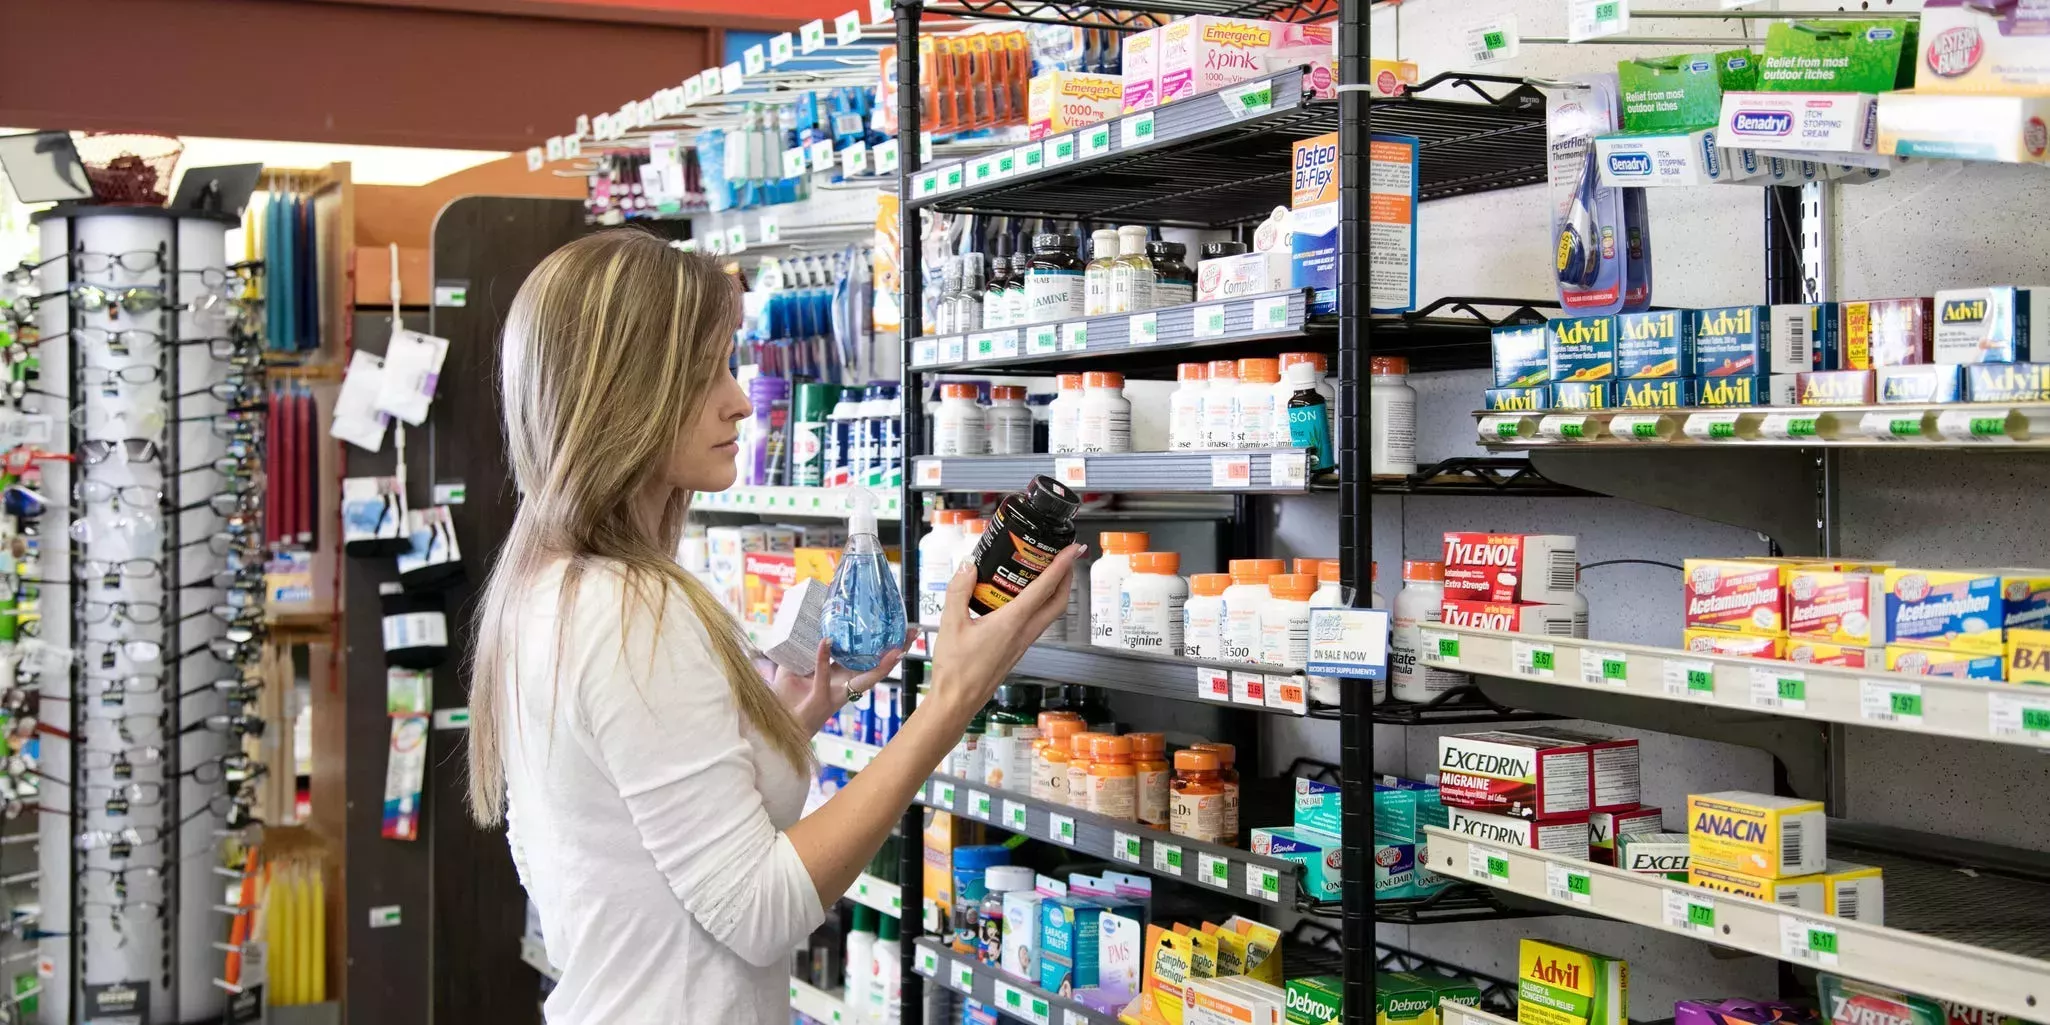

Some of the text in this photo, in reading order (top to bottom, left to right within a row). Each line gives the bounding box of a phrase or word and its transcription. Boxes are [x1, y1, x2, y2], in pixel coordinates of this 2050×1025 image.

[1596, 4, 1613, 18] 6.99
[1217, 50, 1259, 71] pink
[1766, 56, 1848, 69] Relief from most
[1763, 69, 1835, 81] outdoor itches
[1625, 89, 1685, 102] Relief from most
[1063, 104, 1105, 119] 1000 mg
[1627, 100, 1678, 113] outdoor itches
[1804, 110, 1823, 118] ITCH
[1737, 115, 1788, 132] Benadryl
[1803, 120, 1842, 128] STOPPING
[1802, 129, 1829, 137] CREAM
[1296, 144, 1336, 169] Osteo
[1552, 151, 1583, 161] Thermome
[1706, 135, 1718, 174] Benadryl
[1611, 156, 1649, 173] Benadryl
[1658, 159, 1686, 167] STOPPING
[1295, 168, 1333, 196] Bi-Flex
[1944, 301, 1985, 321] Advil
[1619, 312, 1675, 341] Advil
[1698, 308, 1753, 337] Advil
[1552, 317, 1609, 345] Advil
[1554, 383, 1603, 408] Advil
[1621, 381, 1679, 407] Advil
[1700, 377, 1752, 404] Advil
[1494, 388, 1537, 410] Advil
[1563, 424, 1580, 435] 5.77
[1636, 424, 1653, 436] 5.77
[1712, 423, 1730, 434] 5.77
[1791, 420, 1812, 433] 6.27
[1975, 420, 2000, 433] 6.27
[1022, 533, 1036, 545] 30
[1443, 536, 1517, 567] TYLENOL
[996, 565, 1029, 588] CEE
[1444, 580, 1490, 591] Extra Strength
[1689, 586, 1778, 616] Acetaminophen
[1792, 596, 1864, 622] Acetaminophen
[1896, 594, 1990, 623] Acetaminophen
[1442, 604, 1513, 632] TYLENOL
[1124, 635, 1163, 649] Arginine
[1315, 627, 1346, 641] BEST
[1314, 649, 1367, 661] ON SALE NOW
[1535, 652, 1551, 666] 5.67
[2013, 647, 2050, 673] BA
[1336, 666, 1377, 676] SUPPLEMENTS
[1603, 661, 1621, 675] 11.97
[1688, 673, 1706, 685] 4.49
[1285, 688, 1301, 701] 19.77
[1777, 680, 1796, 695] 3.17
[1892, 695, 1914, 711] 7.97
[1442, 746, 1530, 779] EXCEDRIN
[1050, 777, 1061, 788] C
[1441, 772, 1490, 790] MIGRAINE
[1178, 804, 1191, 816] D3
[1453, 814, 1525, 846] EXCEDRIN
[1694, 812, 1768, 844] ANACIN
[1263, 876, 1276, 889] 4.72
[1326, 881, 1342, 891] ON
[1375, 872, 1414, 889] ONE DAILY
[1568, 874, 1584, 890] 6.27
[1692, 905, 1711, 918] 7.77
[1046, 936, 1068, 951] TABLETS
[1813, 932, 1834, 948] 6.17
[1108, 944, 1130, 963] PMS
[1156, 949, 1189, 970] Campho-
[1530, 954, 1580, 990] Advil
[1521, 981, 1550, 997] ALLERGY &
[1286, 987, 1333, 1022] Debrox
[1389, 998, 1429, 1012] Debrox
[1521, 989, 1576, 1013] CONGESTION RELIEF
[1943, 998, 2009, 1025] YRTEC
